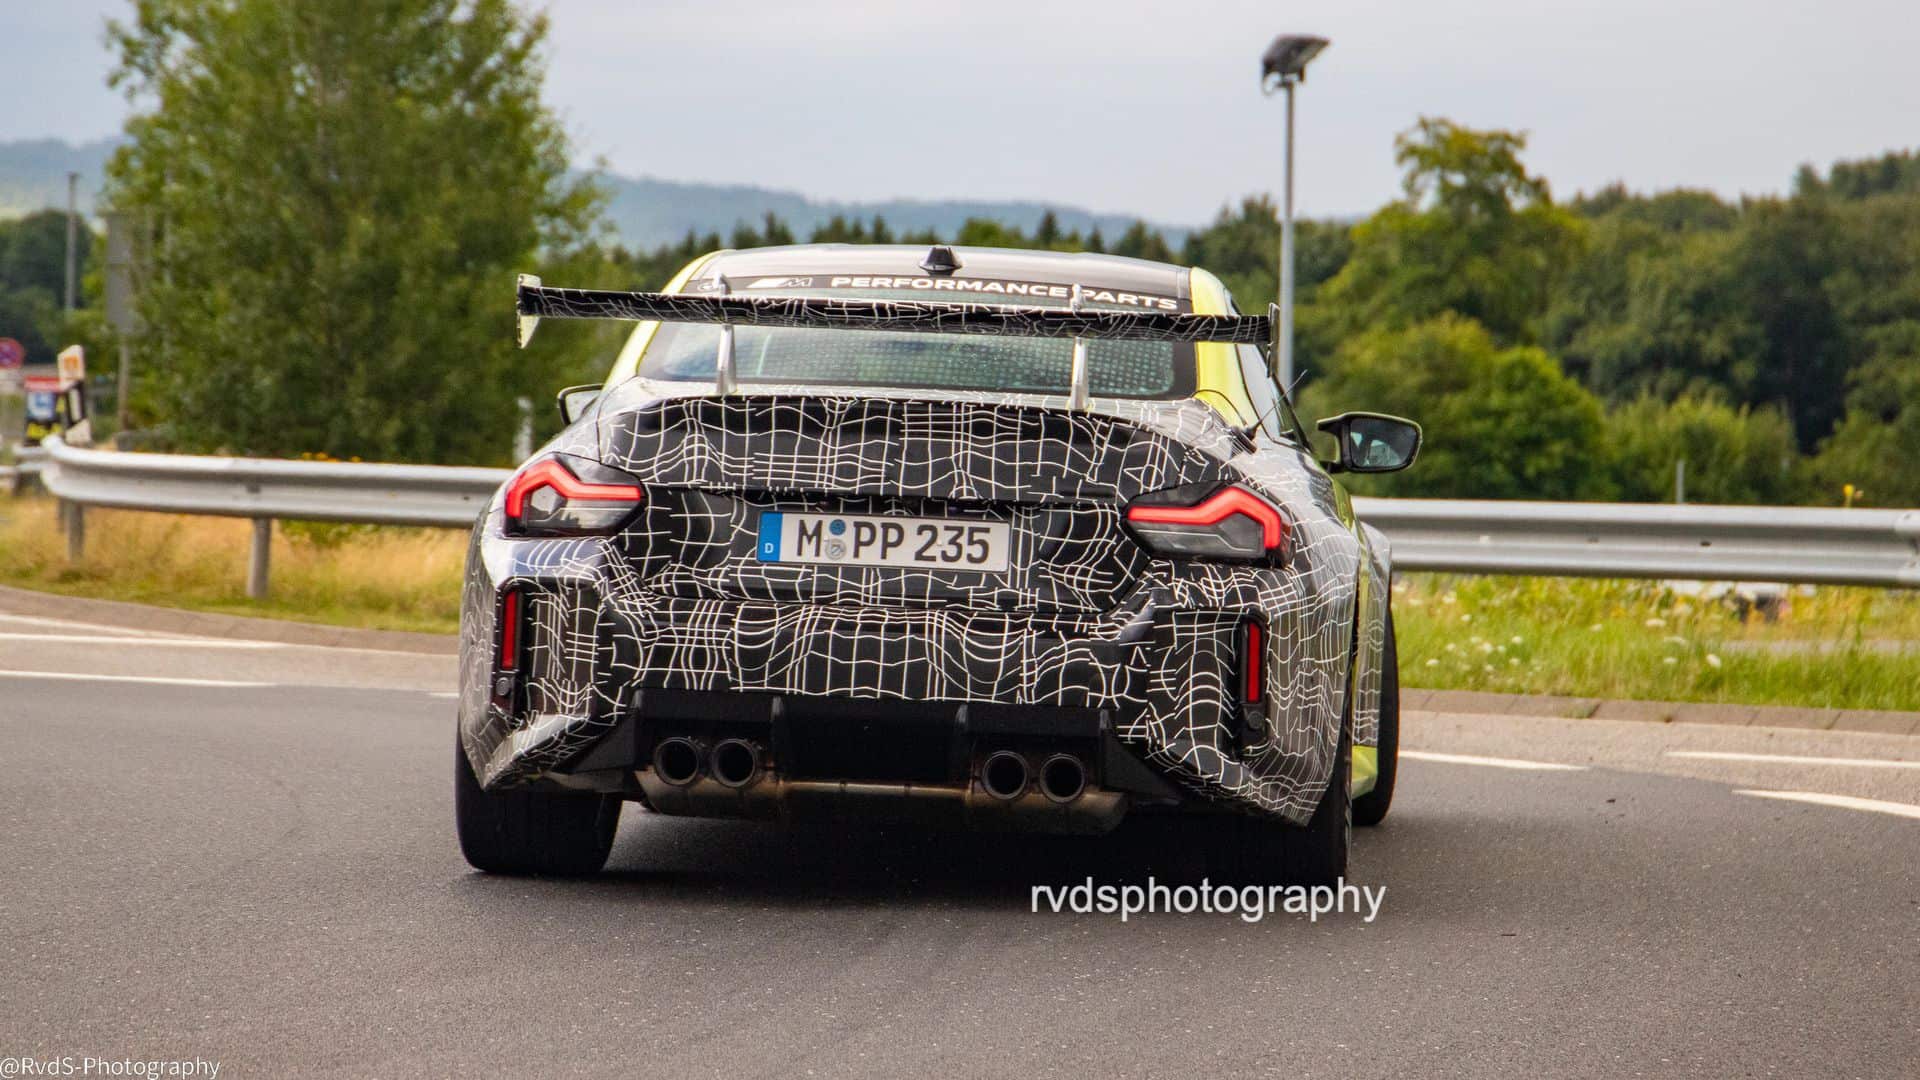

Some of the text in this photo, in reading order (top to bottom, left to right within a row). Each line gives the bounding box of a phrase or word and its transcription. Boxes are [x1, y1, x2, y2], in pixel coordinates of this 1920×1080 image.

[831, 277, 1068, 297] PERFORMANCE
[1079, 288, 1178, 310] PARTS
[764, 542, 774, 554] D
[796, 519, 991, 564] M PP 235
